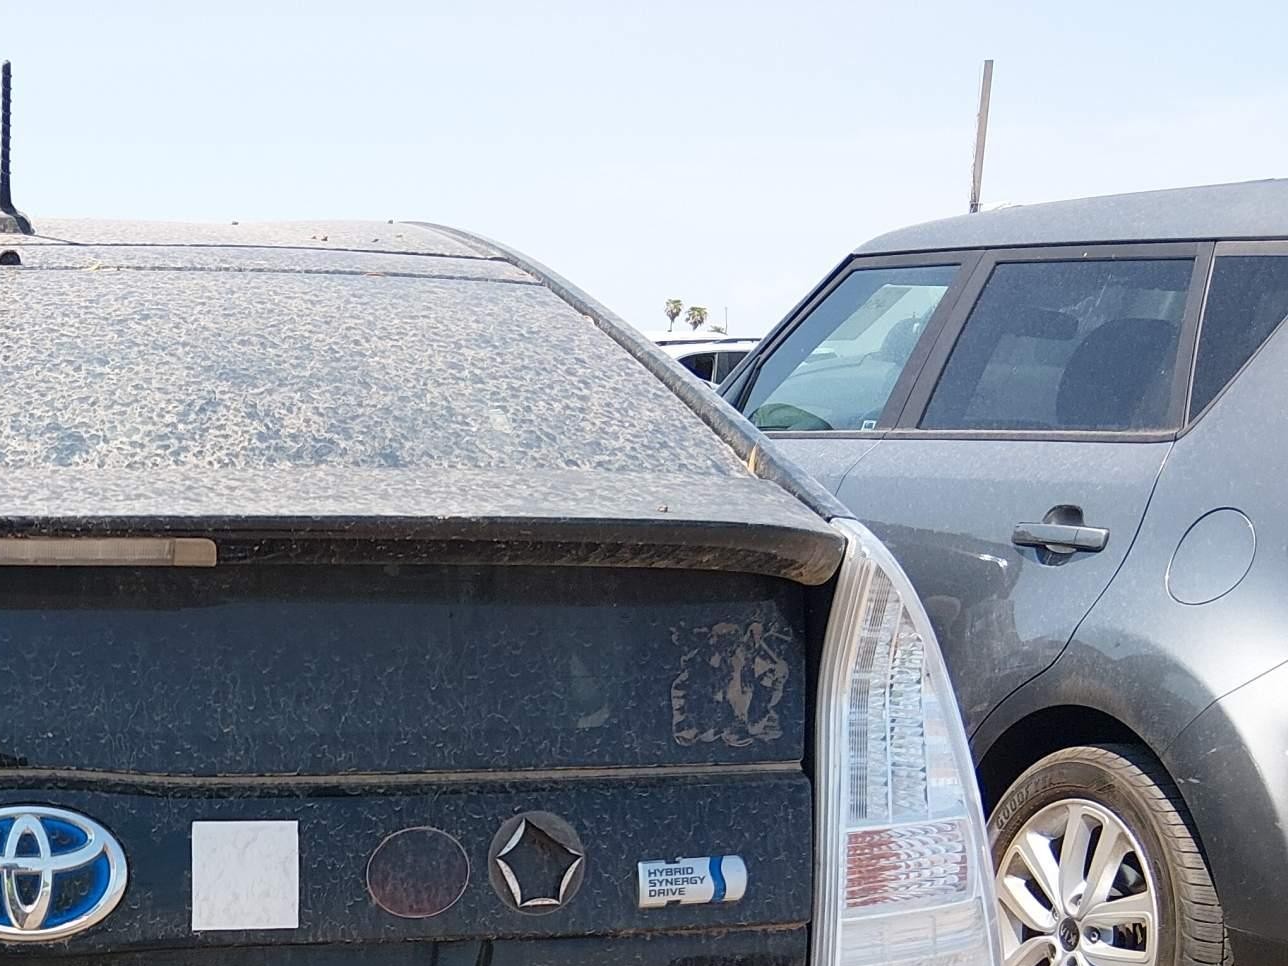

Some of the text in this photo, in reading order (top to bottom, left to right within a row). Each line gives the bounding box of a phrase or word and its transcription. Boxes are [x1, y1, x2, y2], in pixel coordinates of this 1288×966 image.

[648, 866, 694, 878] HYBRID
[648, 876, 706, 888] SYNERGY
[649, 887, 686, 898] DRIVE
